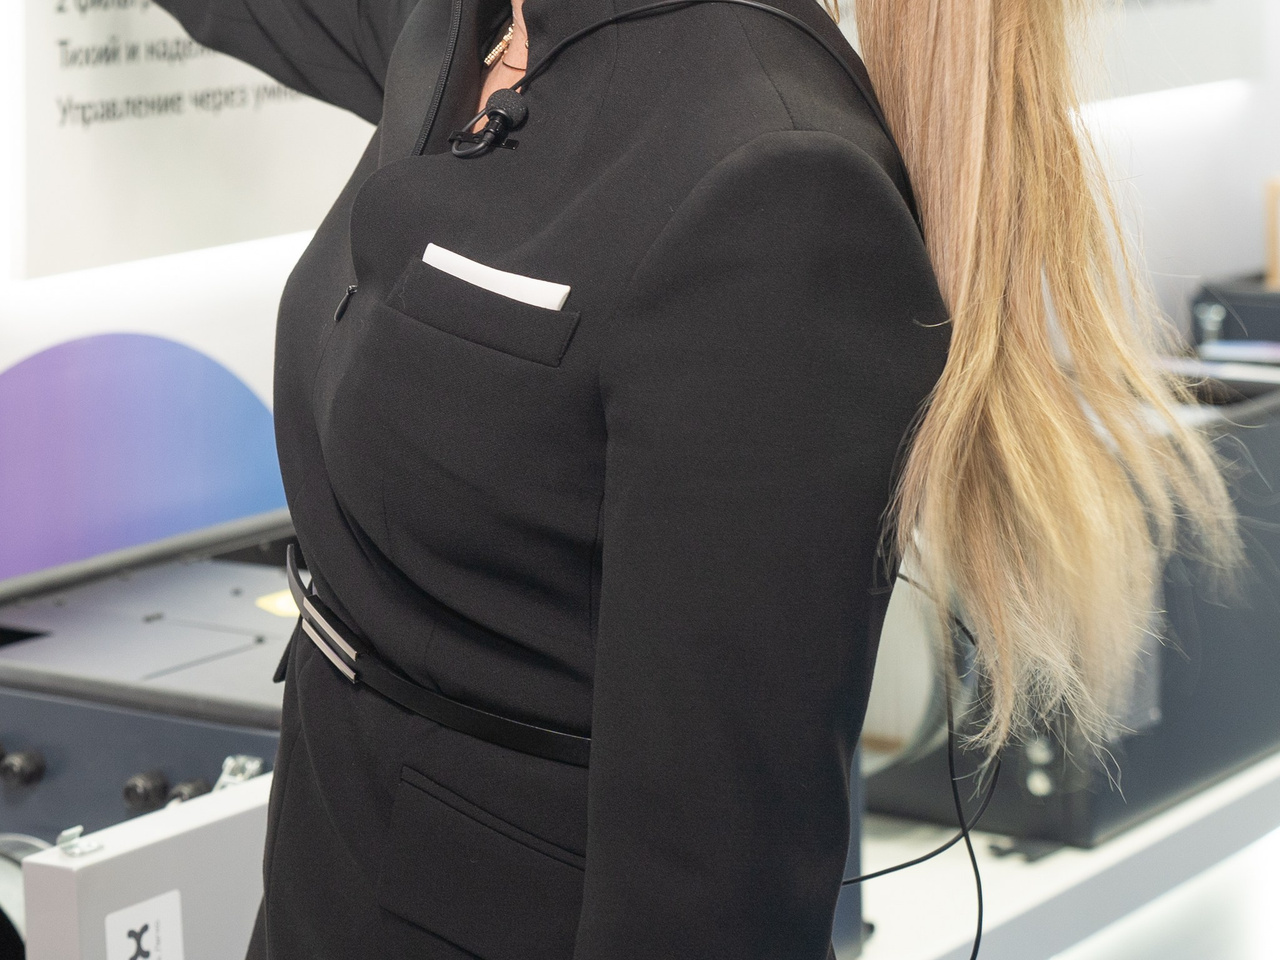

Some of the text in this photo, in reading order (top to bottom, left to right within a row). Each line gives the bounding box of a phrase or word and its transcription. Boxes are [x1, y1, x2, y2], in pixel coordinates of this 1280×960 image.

[58, 36, 121, 68] Тихий
[125, 43, 139, 63] и
[56, 91, 184, 130] Управление
[188, 86, 248, 115] через
